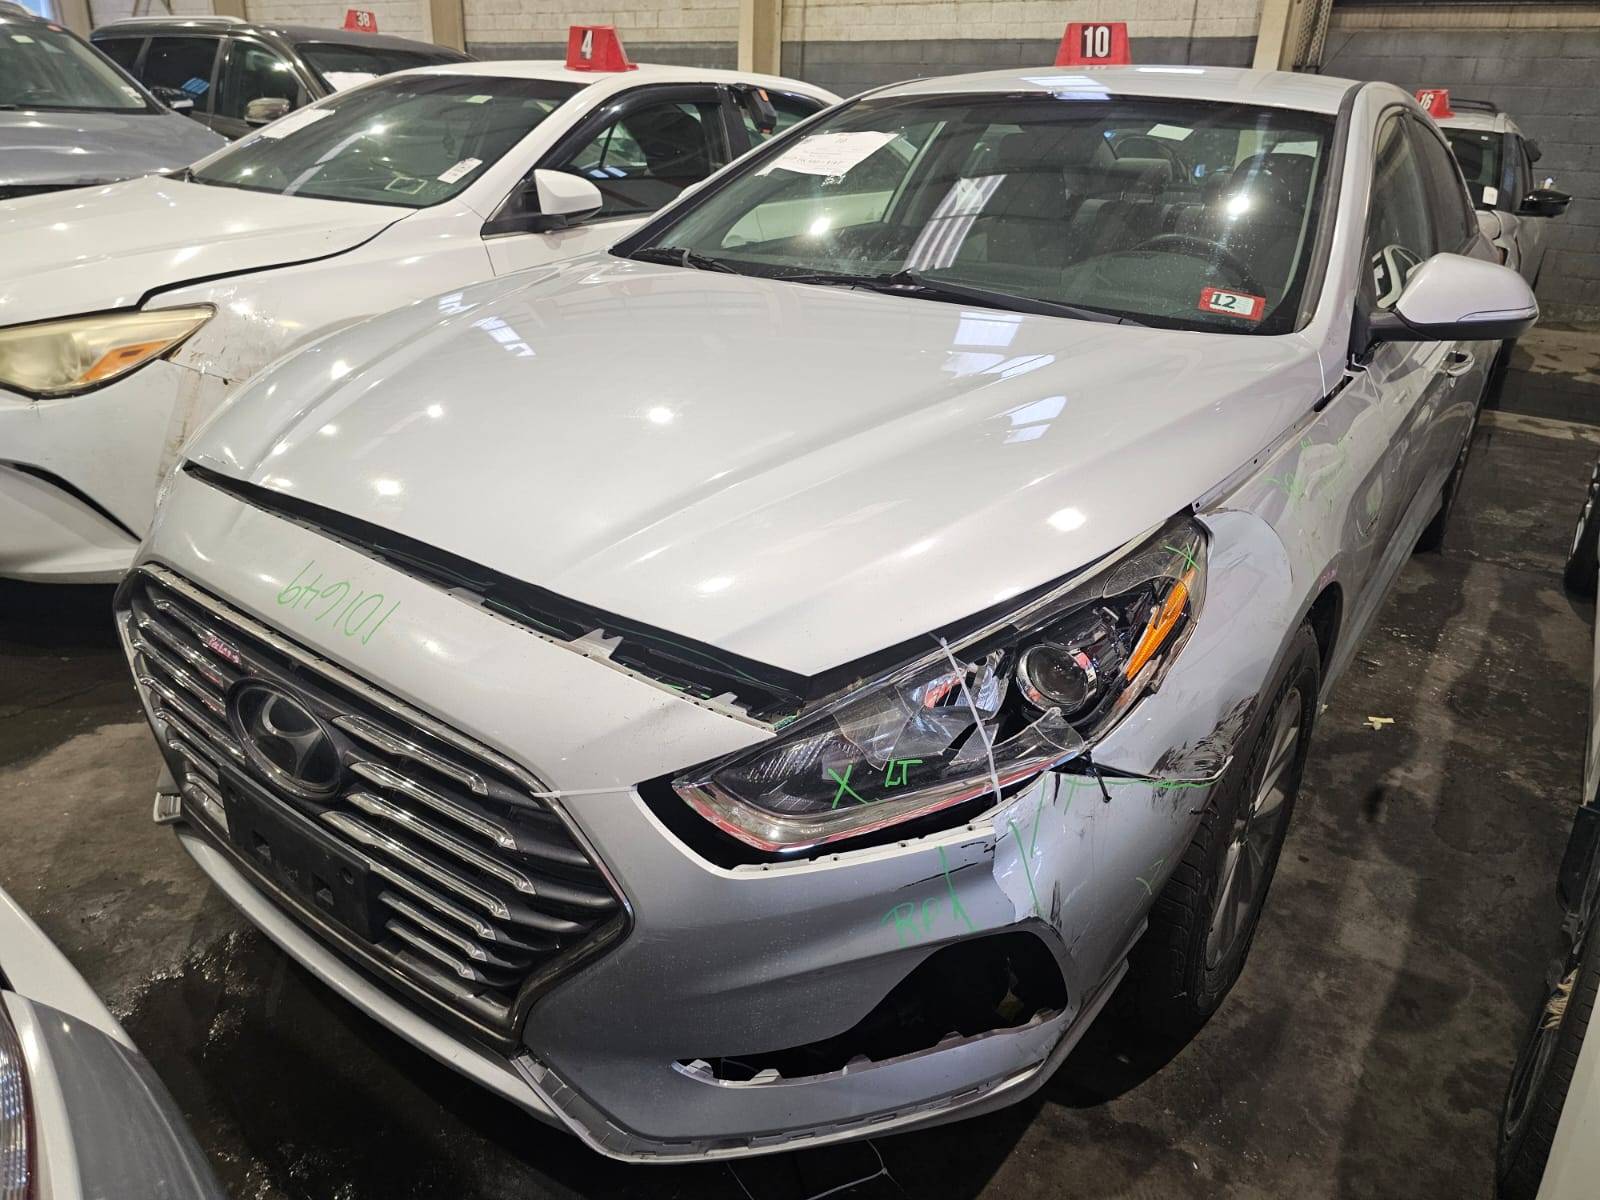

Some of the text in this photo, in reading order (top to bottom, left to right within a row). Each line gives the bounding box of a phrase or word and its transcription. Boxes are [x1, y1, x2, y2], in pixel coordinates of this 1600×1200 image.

[581, 30, 593, 59] 4
[1084, 25, 1110, 58] 10
[1420, 93, 1434, 110] 16
[1211, 294, 1237, 309] 12
[277, 559, 401, 646] 101649
[884, 759, 923, 788] LT
